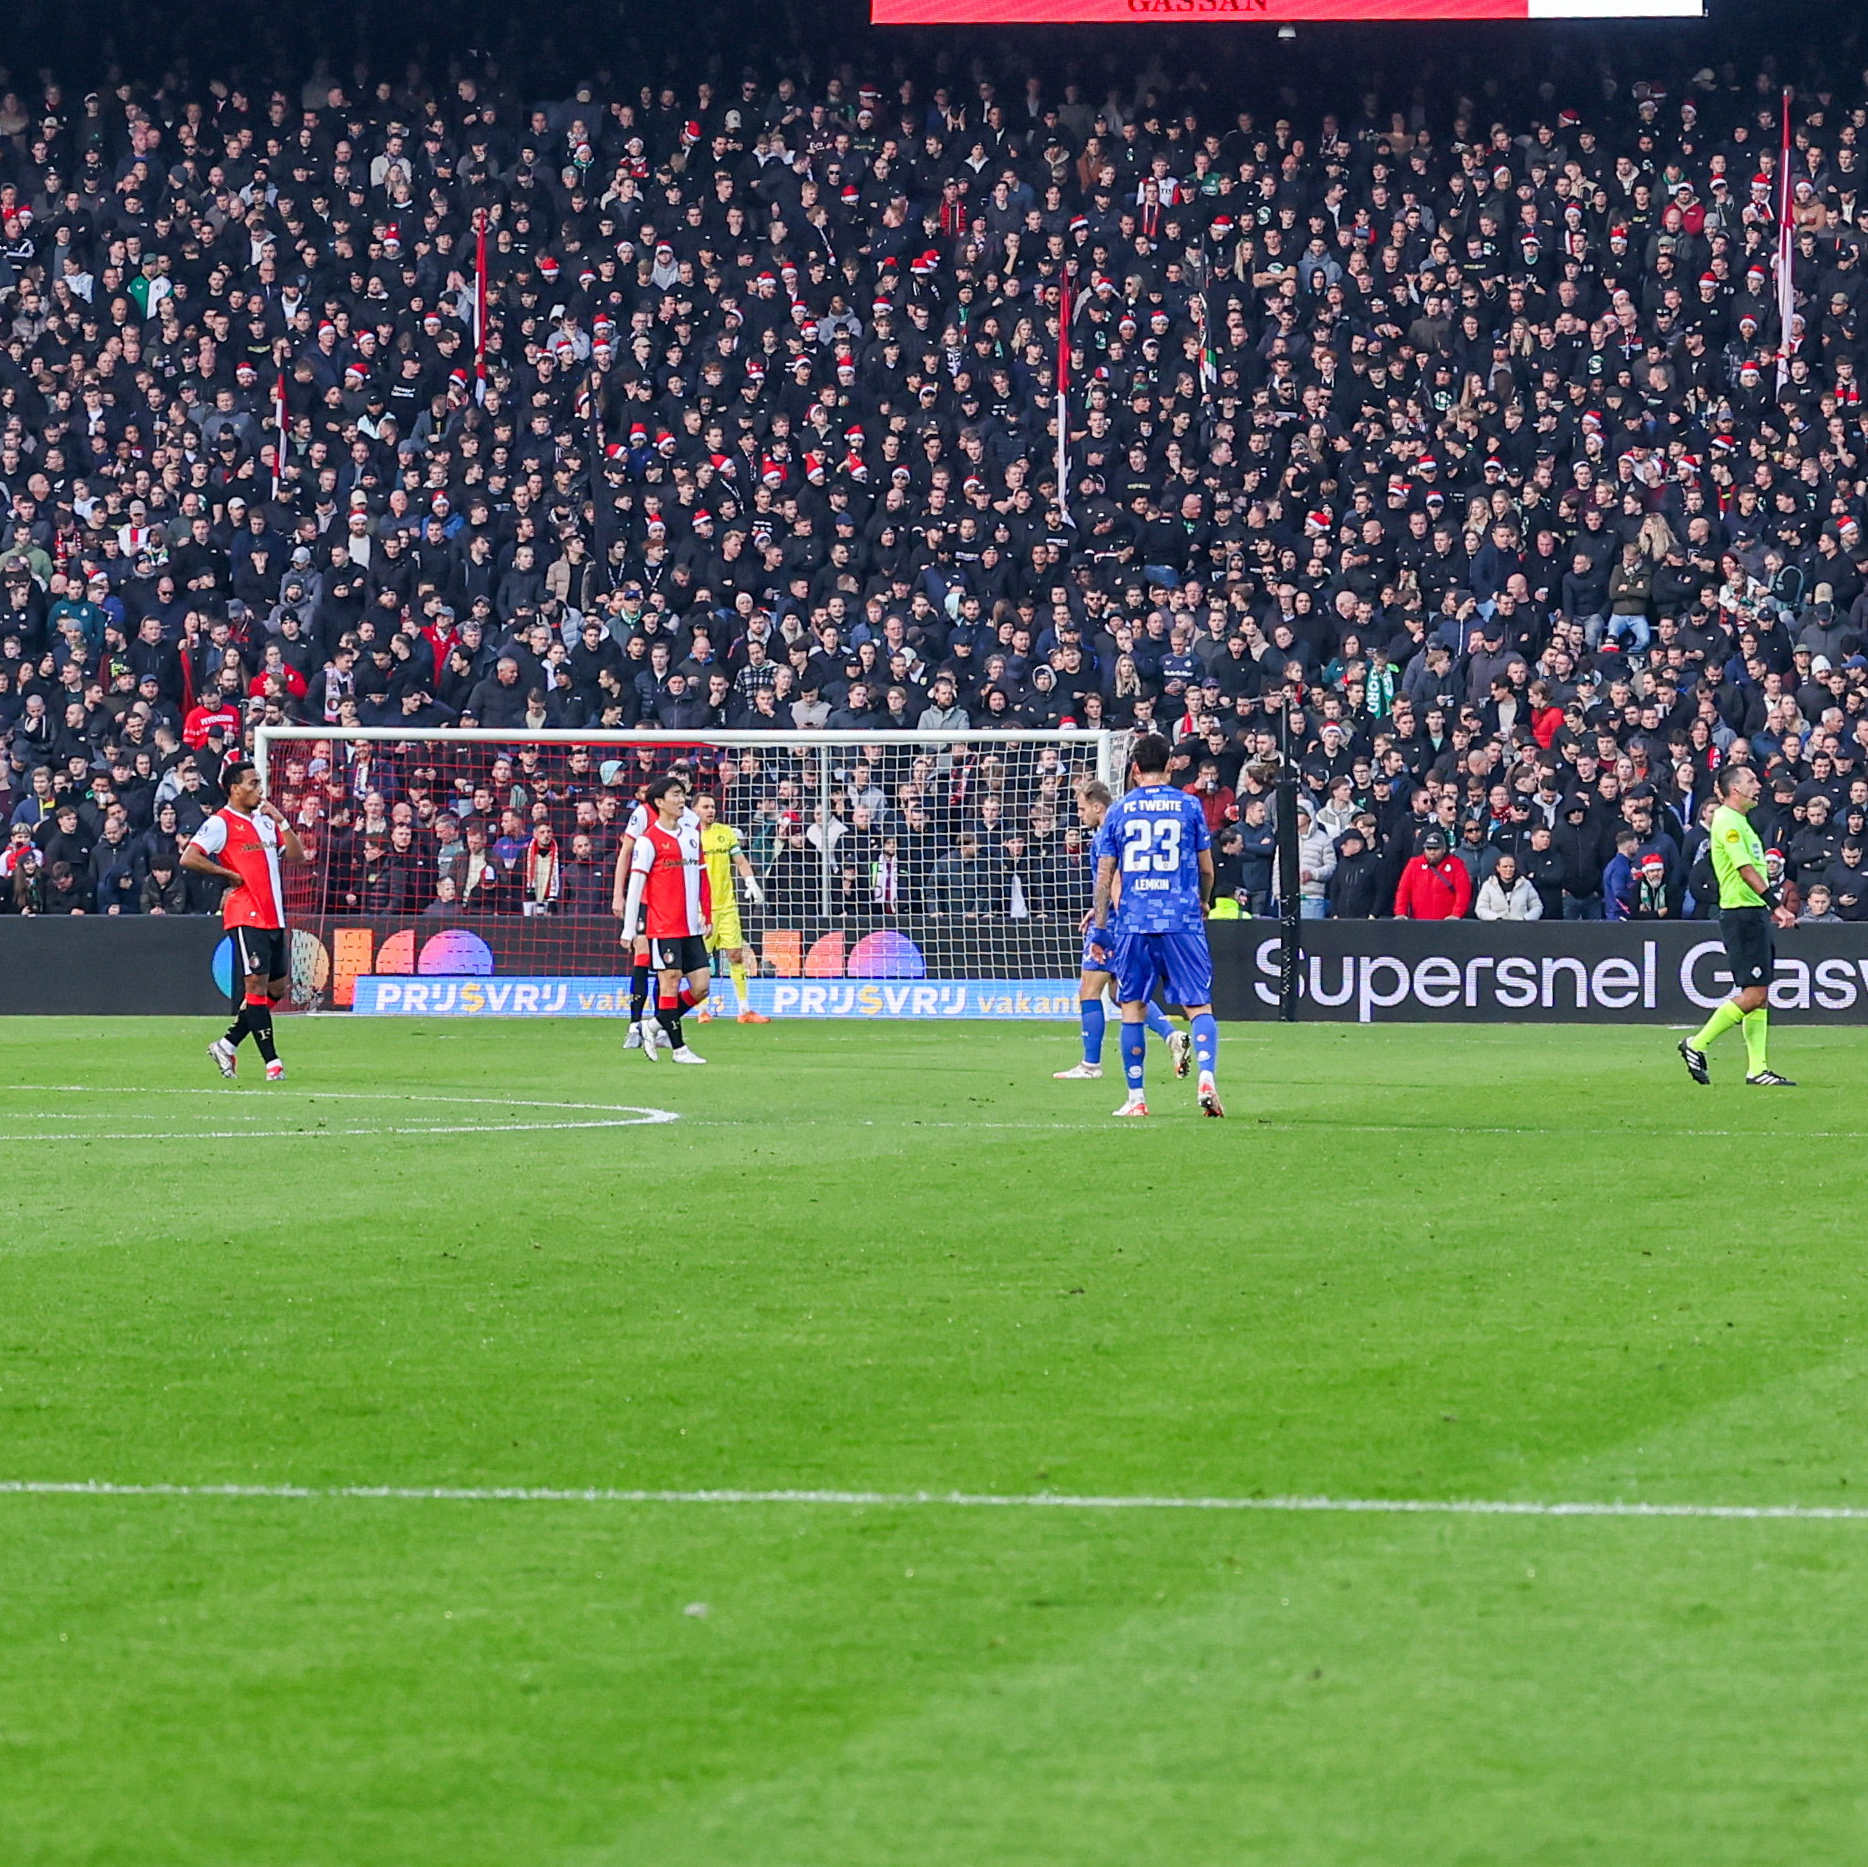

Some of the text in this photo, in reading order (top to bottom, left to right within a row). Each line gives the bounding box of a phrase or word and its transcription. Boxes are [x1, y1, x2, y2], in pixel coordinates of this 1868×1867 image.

[1123, 799, 1182, 813] FC TWENTE
[1123, 819, 1181, 872] 23
[1135, 878, 1169, 891] LEMKIN
[1253, 938, 1657, 1022] Supersnel
